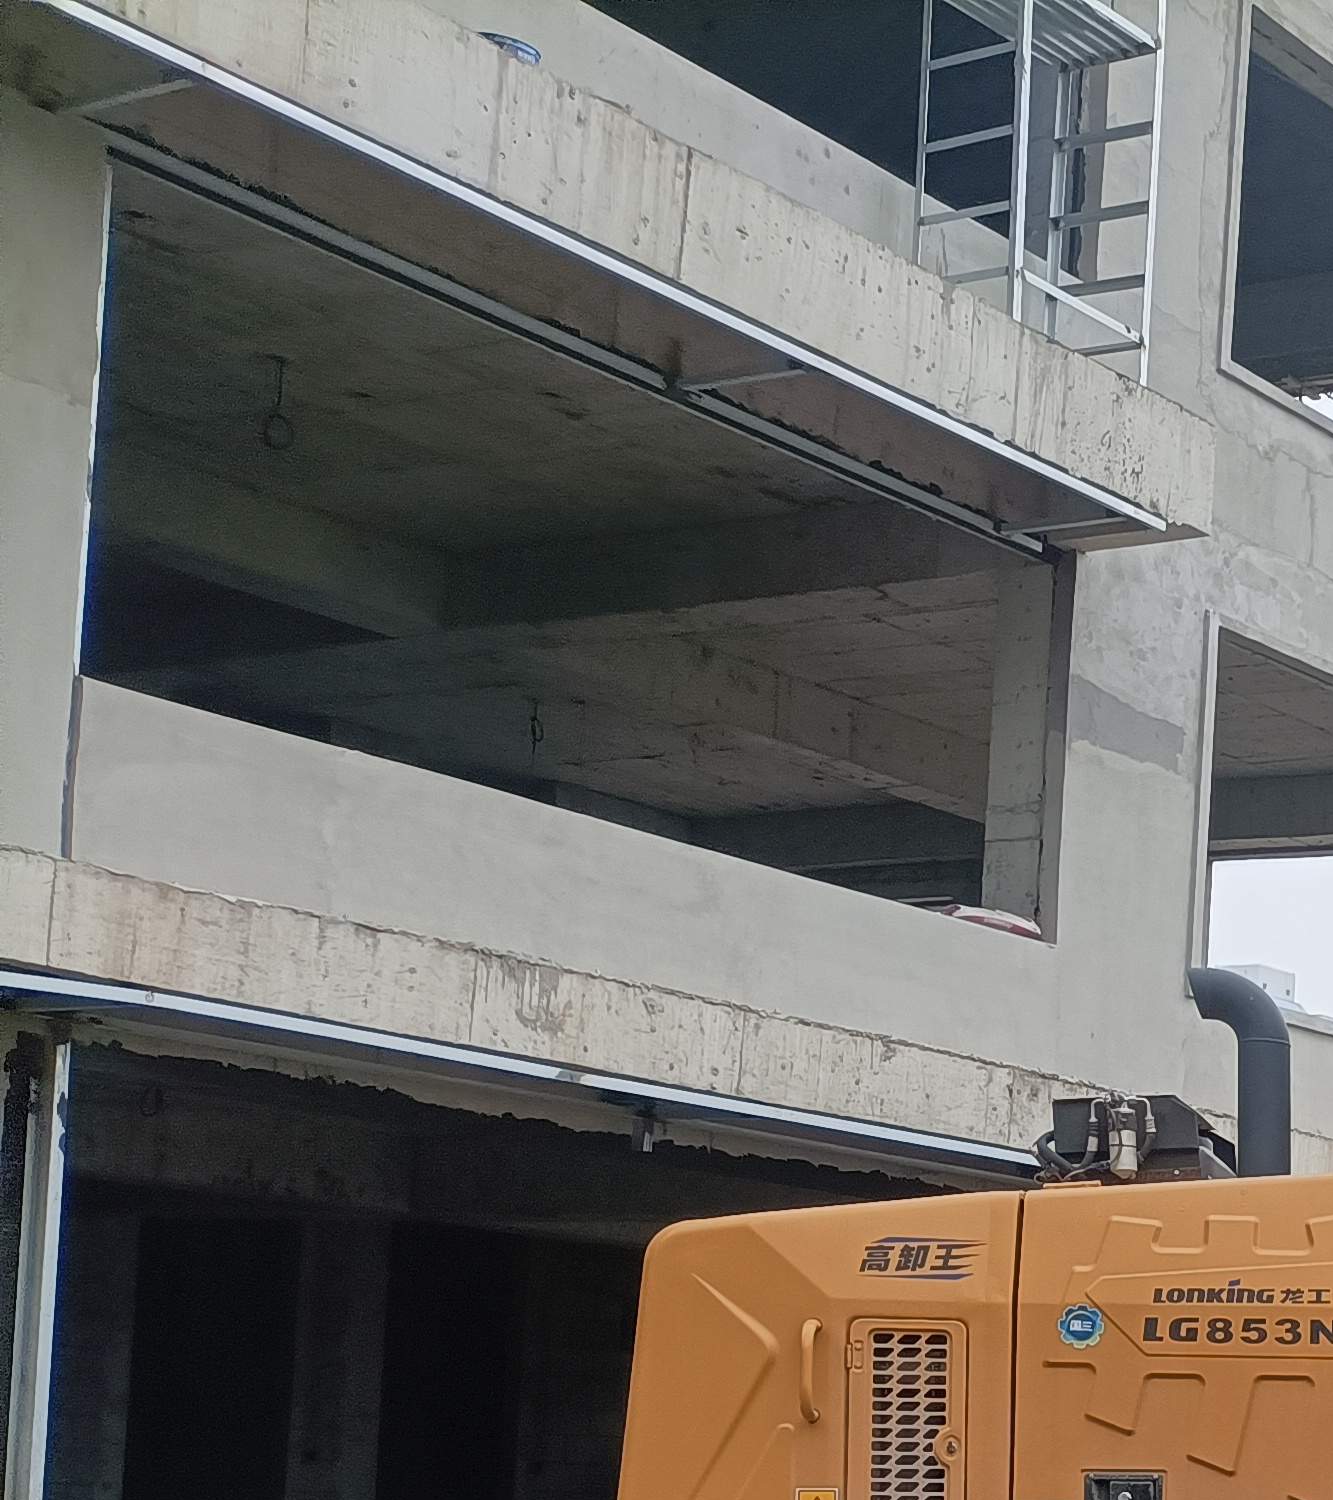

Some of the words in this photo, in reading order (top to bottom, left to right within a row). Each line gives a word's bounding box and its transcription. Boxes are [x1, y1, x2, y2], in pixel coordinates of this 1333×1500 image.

[859, 1243, 987, 1272] 高卸王
[1280, 1288, 1331, 1304] 龙工
